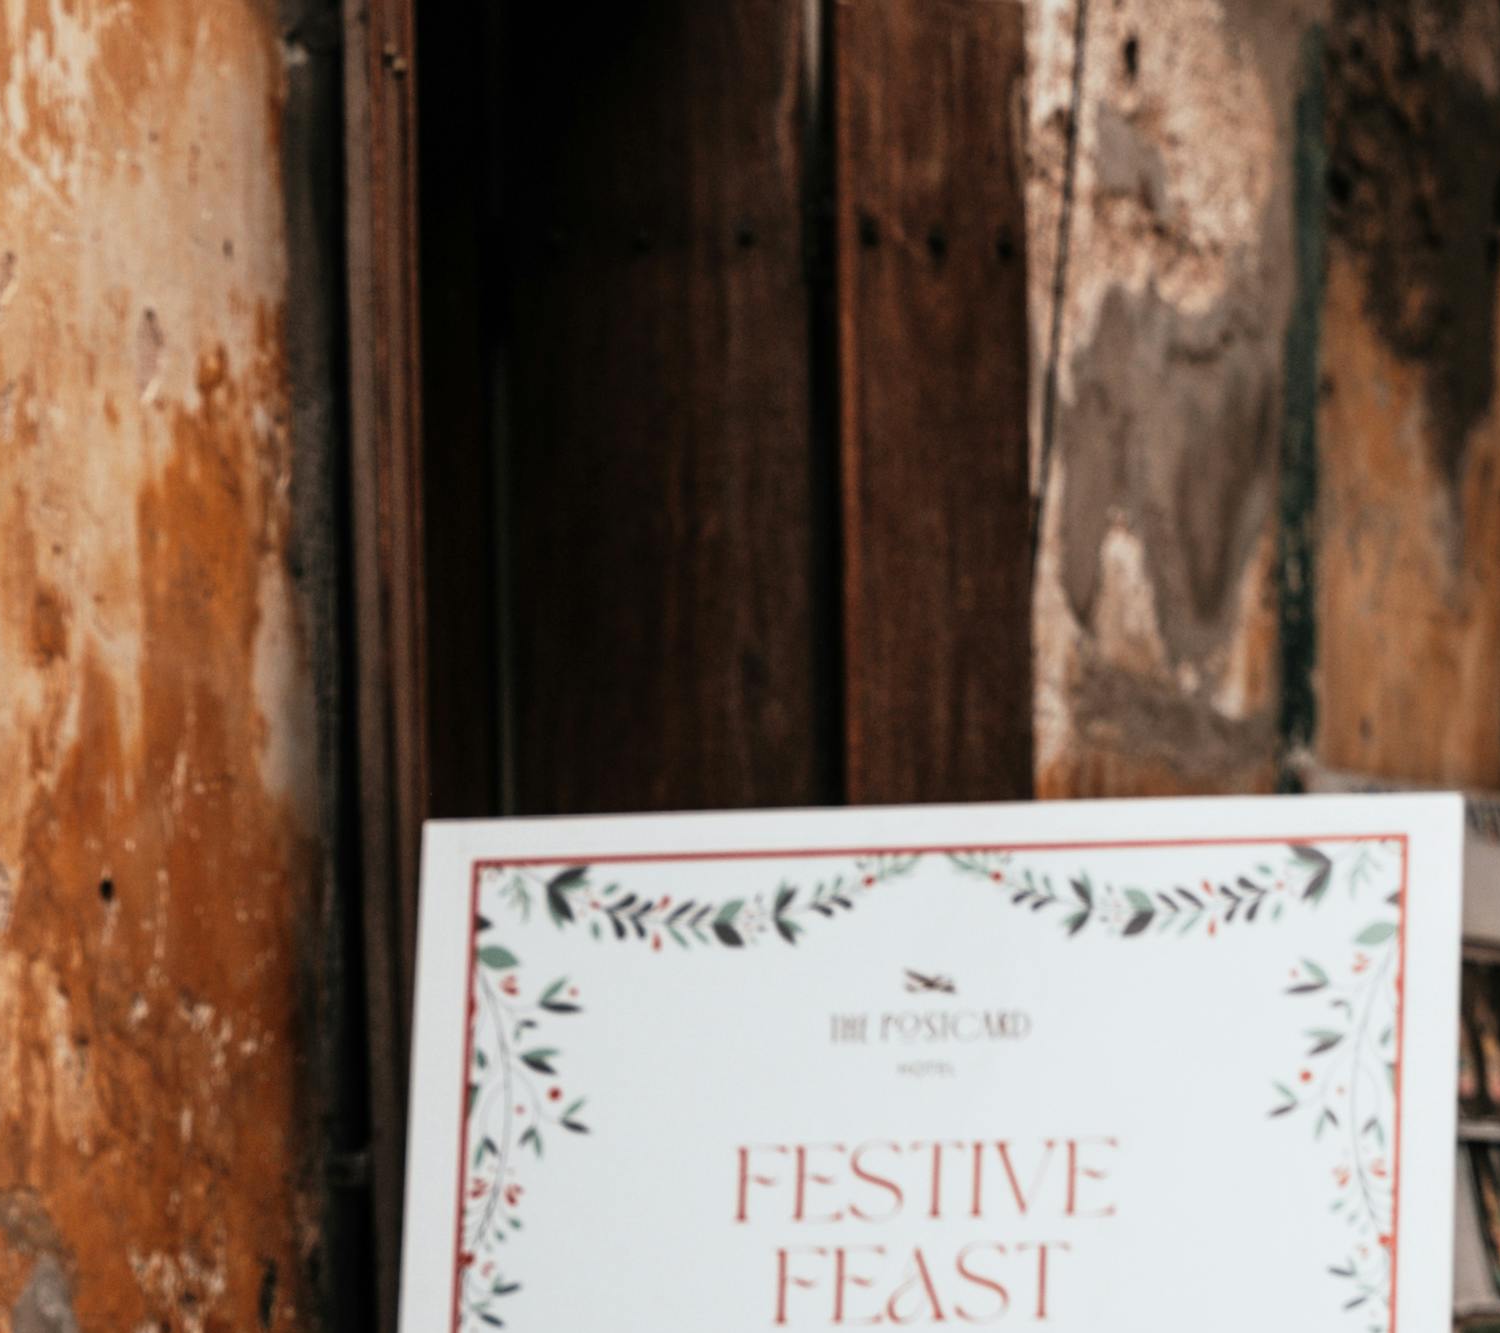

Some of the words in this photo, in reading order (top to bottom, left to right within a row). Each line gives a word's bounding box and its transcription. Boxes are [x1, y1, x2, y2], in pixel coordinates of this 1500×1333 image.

[878, 1008, 1033, 1045] POSTCARD
[734, 1136, 1120, 1225] FESTIVE
[770, 1241, 1071, 1328] FEAST
